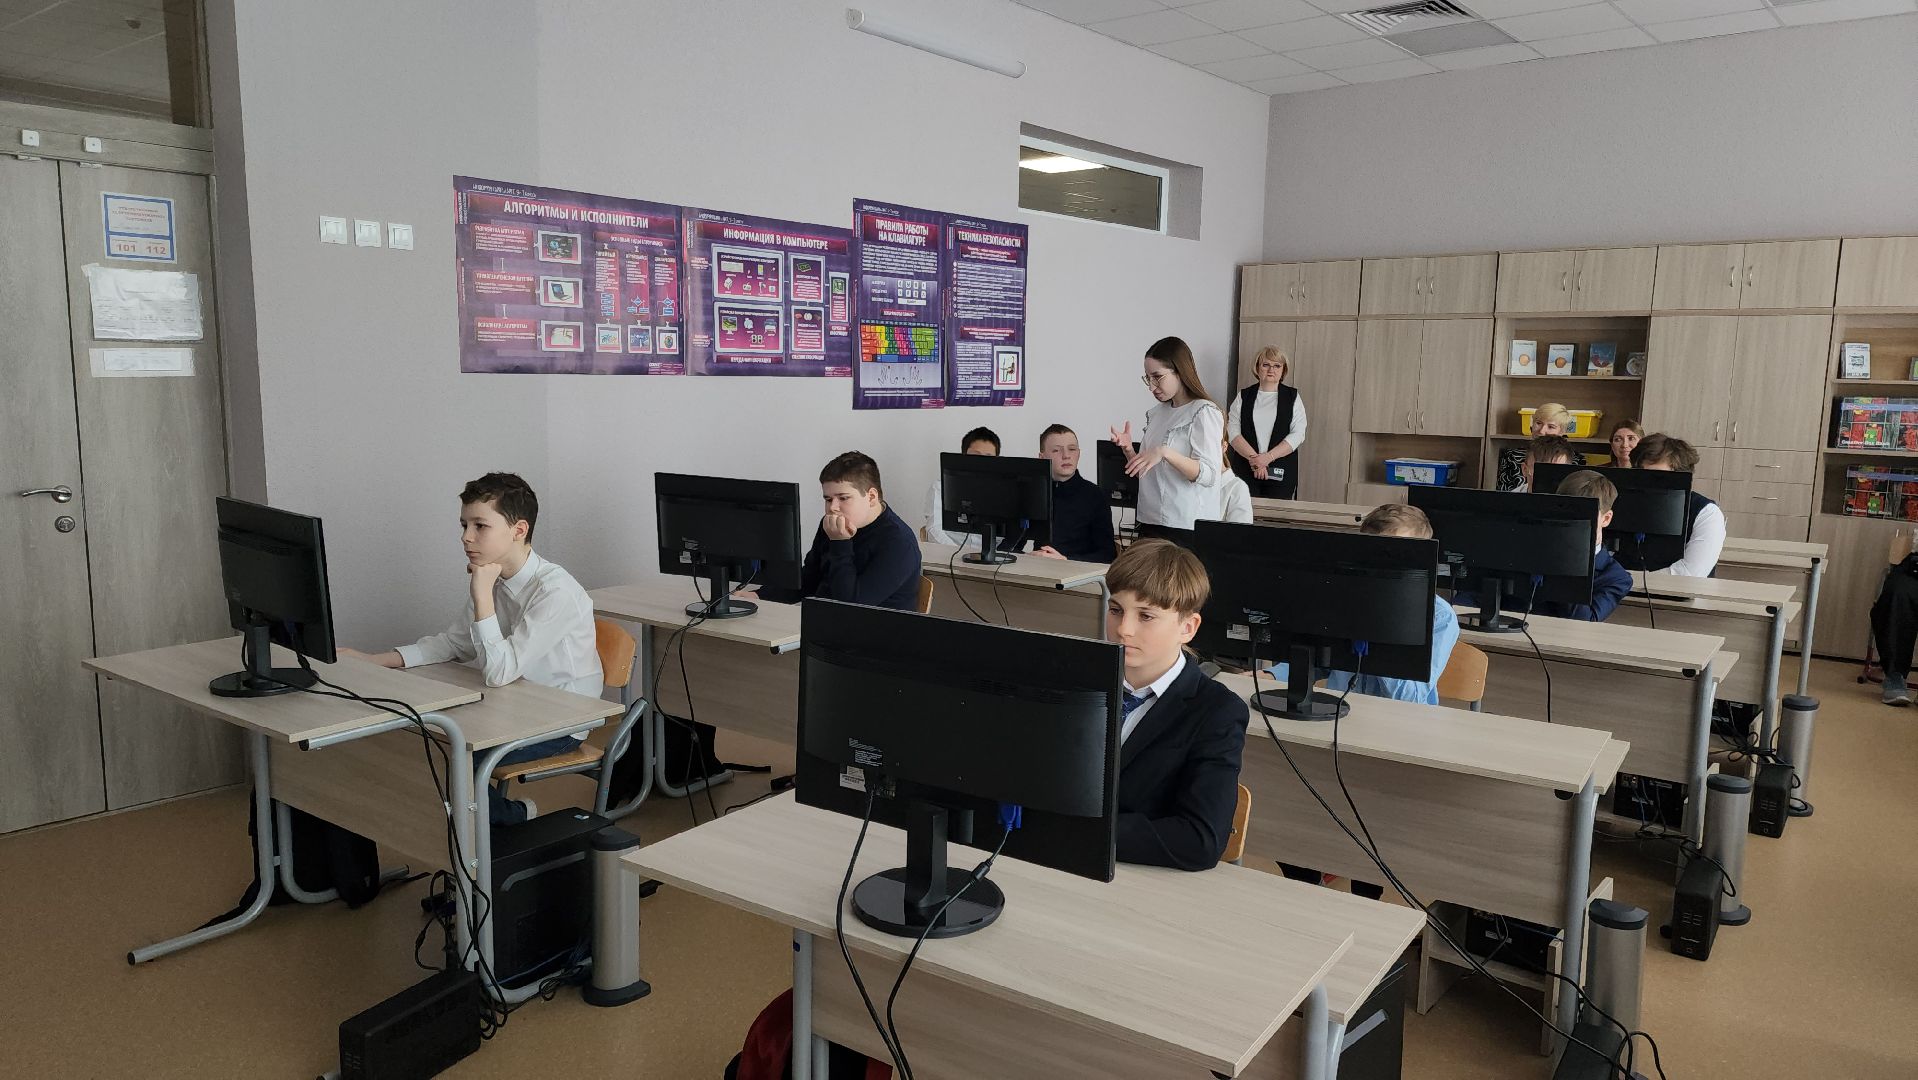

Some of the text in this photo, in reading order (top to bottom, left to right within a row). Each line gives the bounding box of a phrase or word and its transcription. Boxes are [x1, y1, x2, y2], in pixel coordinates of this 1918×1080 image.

[503, 200, 649, 229] АЛГОРИТМЫ И ИСПОЛНИТЕЛИ
[875, 219, 929, 236] ПРАВИЛА РАБОТЫ
[723, 228, 829, 251] ИНФОРМАЦИЯ В КОМПЬЮТЕРЕ
[878, 231, 887, 241] НА
[957, 230, 982, 243] ТЕХНИКА
[116, 243, 136, 252] 101
[146, 245, 167, 255] 112
